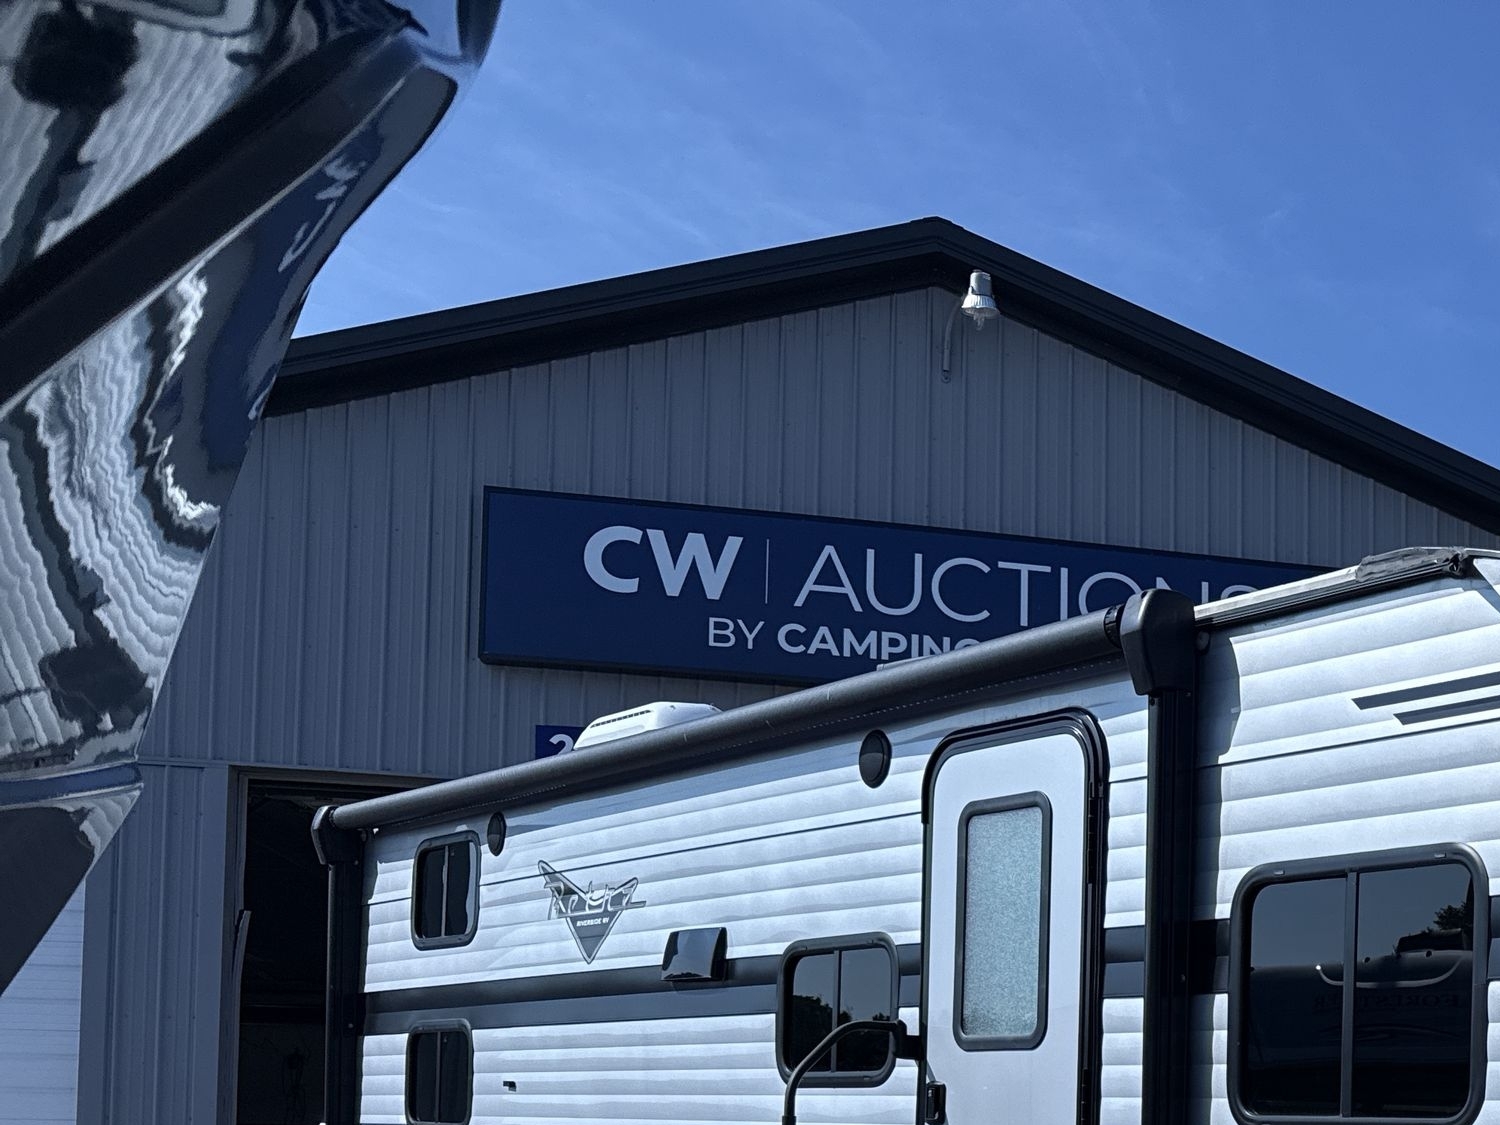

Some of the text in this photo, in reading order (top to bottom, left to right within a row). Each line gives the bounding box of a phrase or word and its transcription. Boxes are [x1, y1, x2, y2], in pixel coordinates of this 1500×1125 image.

[583, 525, 1258, 627] CW AUCTIO
[708, 617, 765, 649] BY
